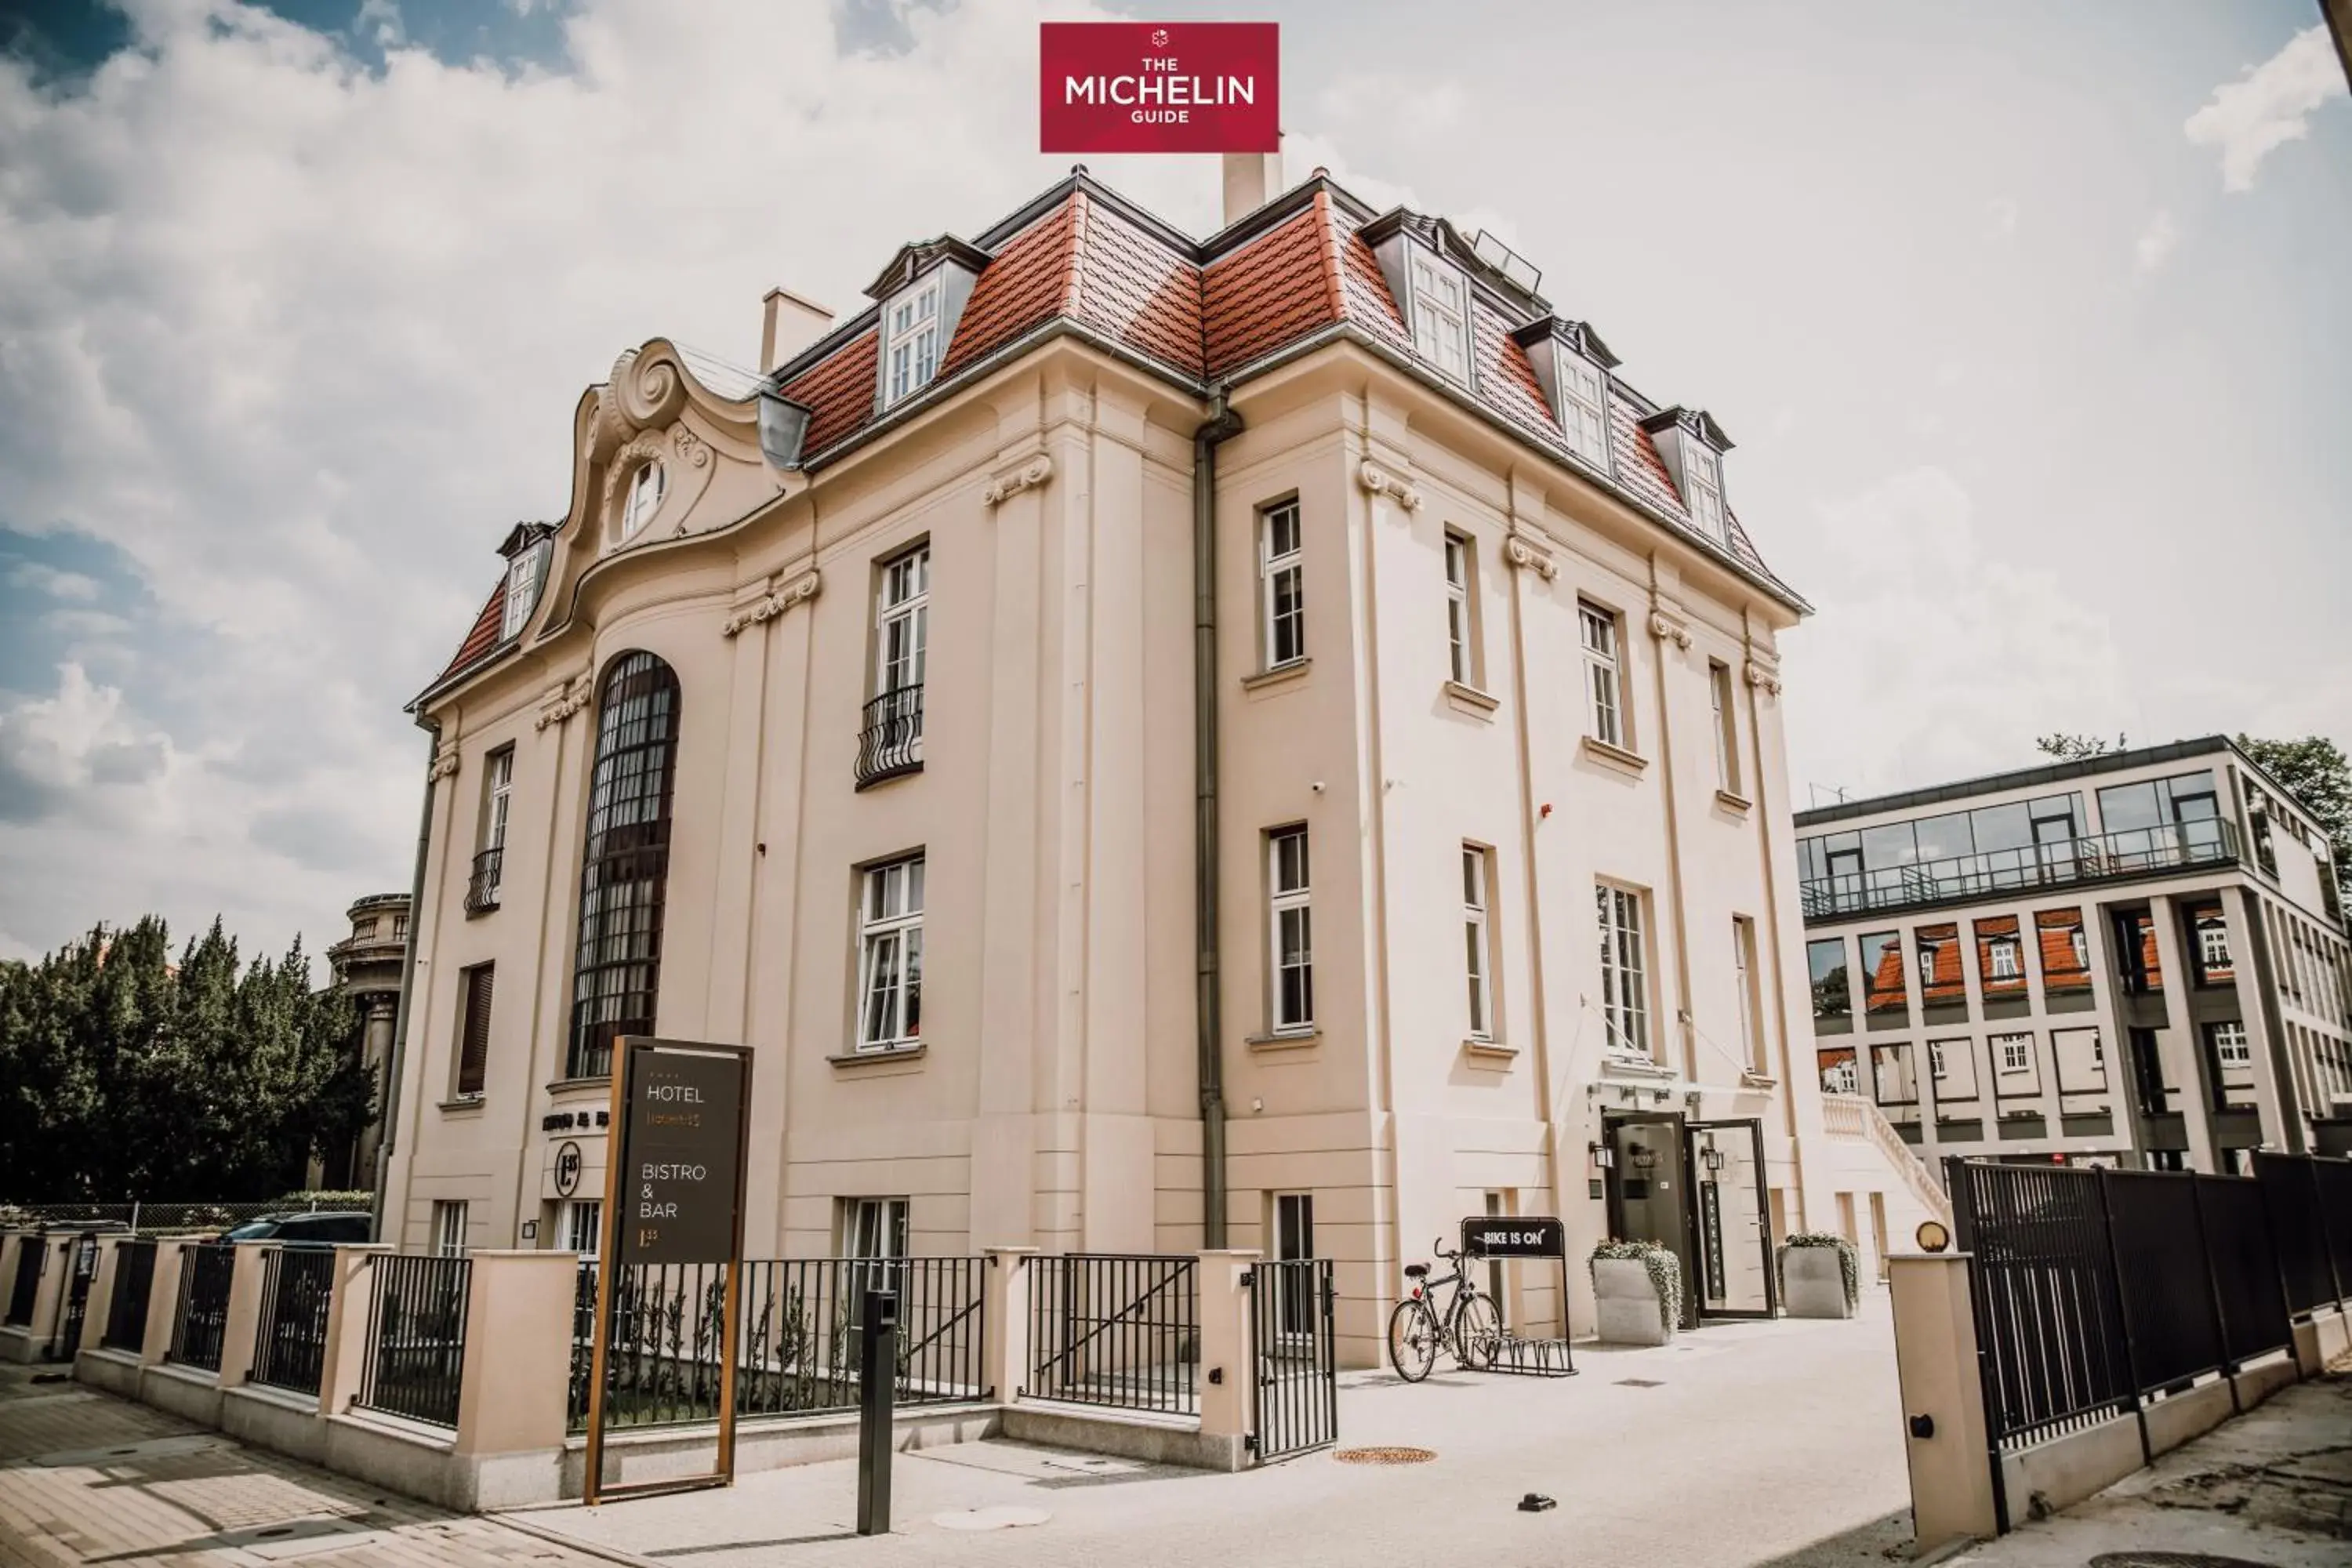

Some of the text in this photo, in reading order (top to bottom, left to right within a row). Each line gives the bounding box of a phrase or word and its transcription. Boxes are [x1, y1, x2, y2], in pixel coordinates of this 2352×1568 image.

[647, 1085, 705, 1103] HOTEL
[642, 1163, 706, 1181] BISTRO
[642, 1183, 653, 1199] &
[641, 1203, 678, 1218] BAR
[1484, 1232, 1507, 1245] BIKE
[1509, 1232, 1522, 1245] IS
